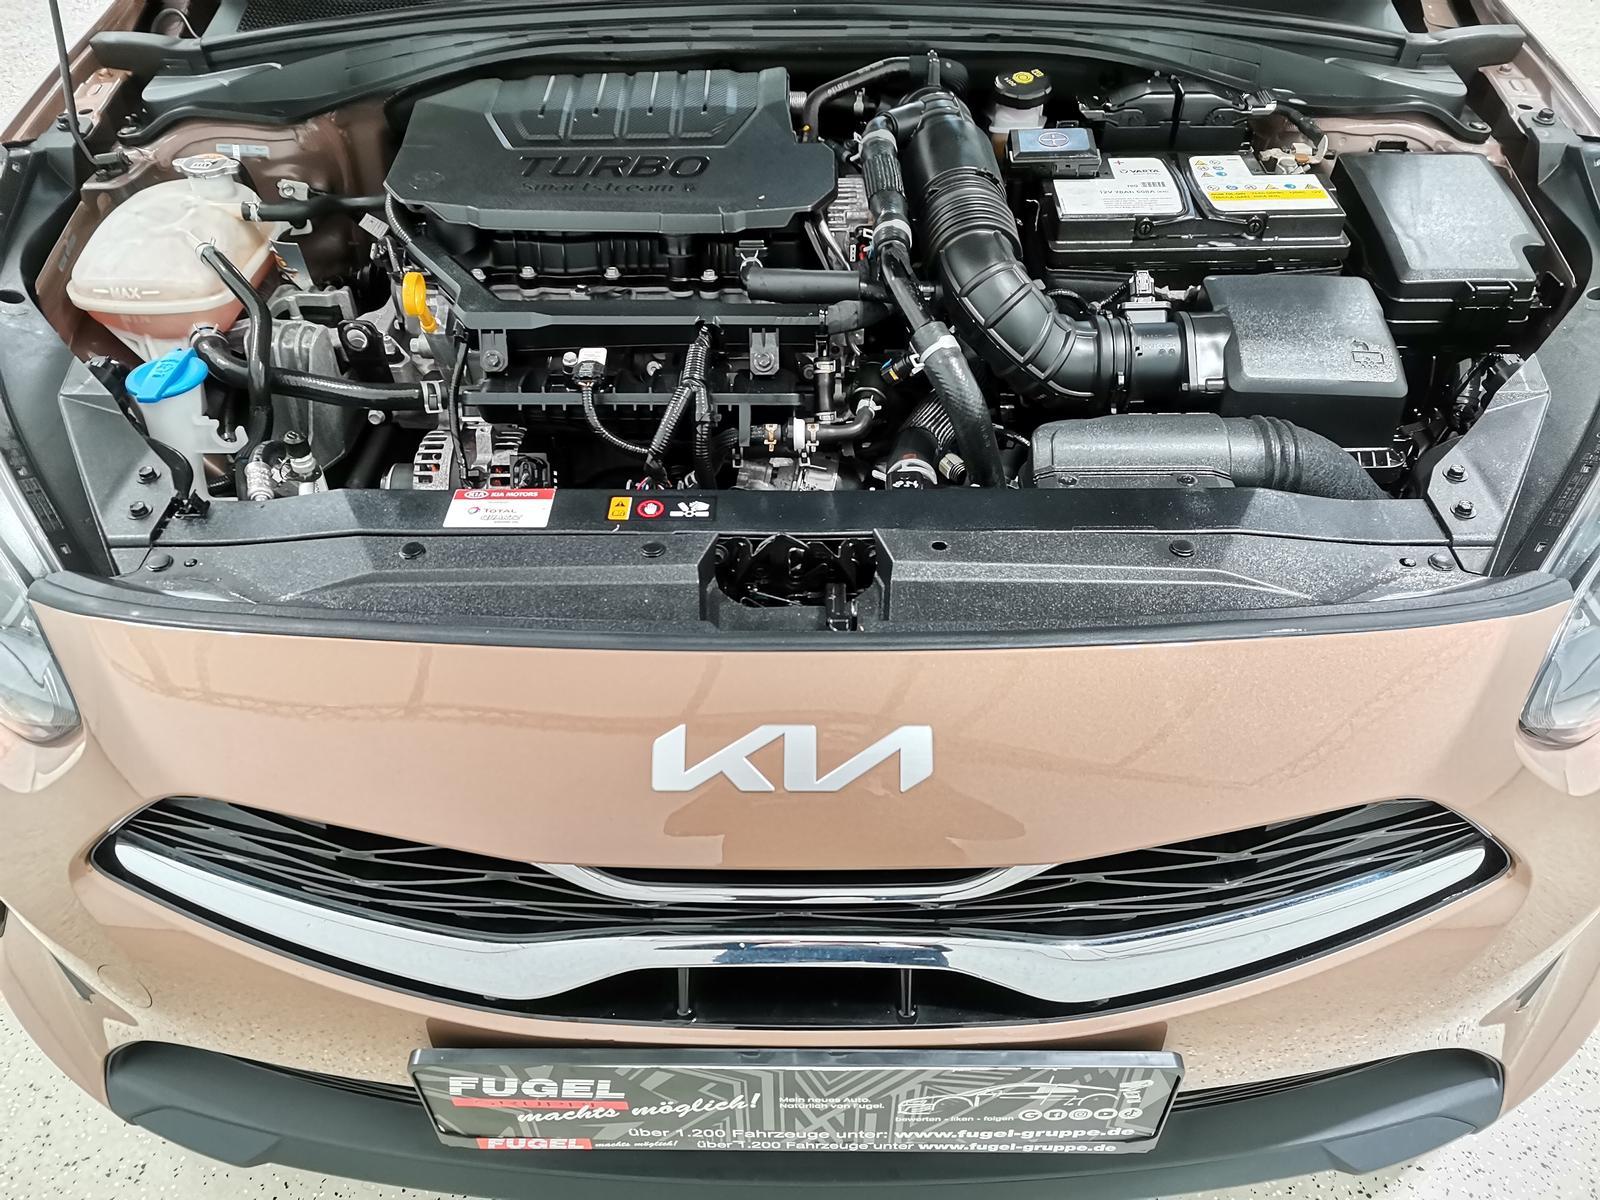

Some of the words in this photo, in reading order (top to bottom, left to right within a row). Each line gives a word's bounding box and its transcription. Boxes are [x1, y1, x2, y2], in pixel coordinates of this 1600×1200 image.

[519, 155, 711, 178] TURBO
[651, 723, 934, 793] KIA
[449, 1076, 626, 1099] FUGEL
[517, 1105, 620, 1122] machts
[631, 1093, 761, 1118] möglich!
[487, 1138, 585, 1150] FUGEL
[628, 1128, 670, 1138] über
[678, 1128, 726, 1138] 1.200
[732, 1129, 830, 1140] Fahrzeuge
[836, 1130, 888, 1139] unter:
[894, 1127, 1136, 1140] www.fugel-gruppe.de
[697, 1140, 733, 1150] über
[734, 1141, 781, 1150] 1.200
[786, 1142, 872, 1152] Fahrzeuge
[874, 1142, 914, 1151] unter
[918, 1142, 1117, 1153] www.fugel-gruppe.de
